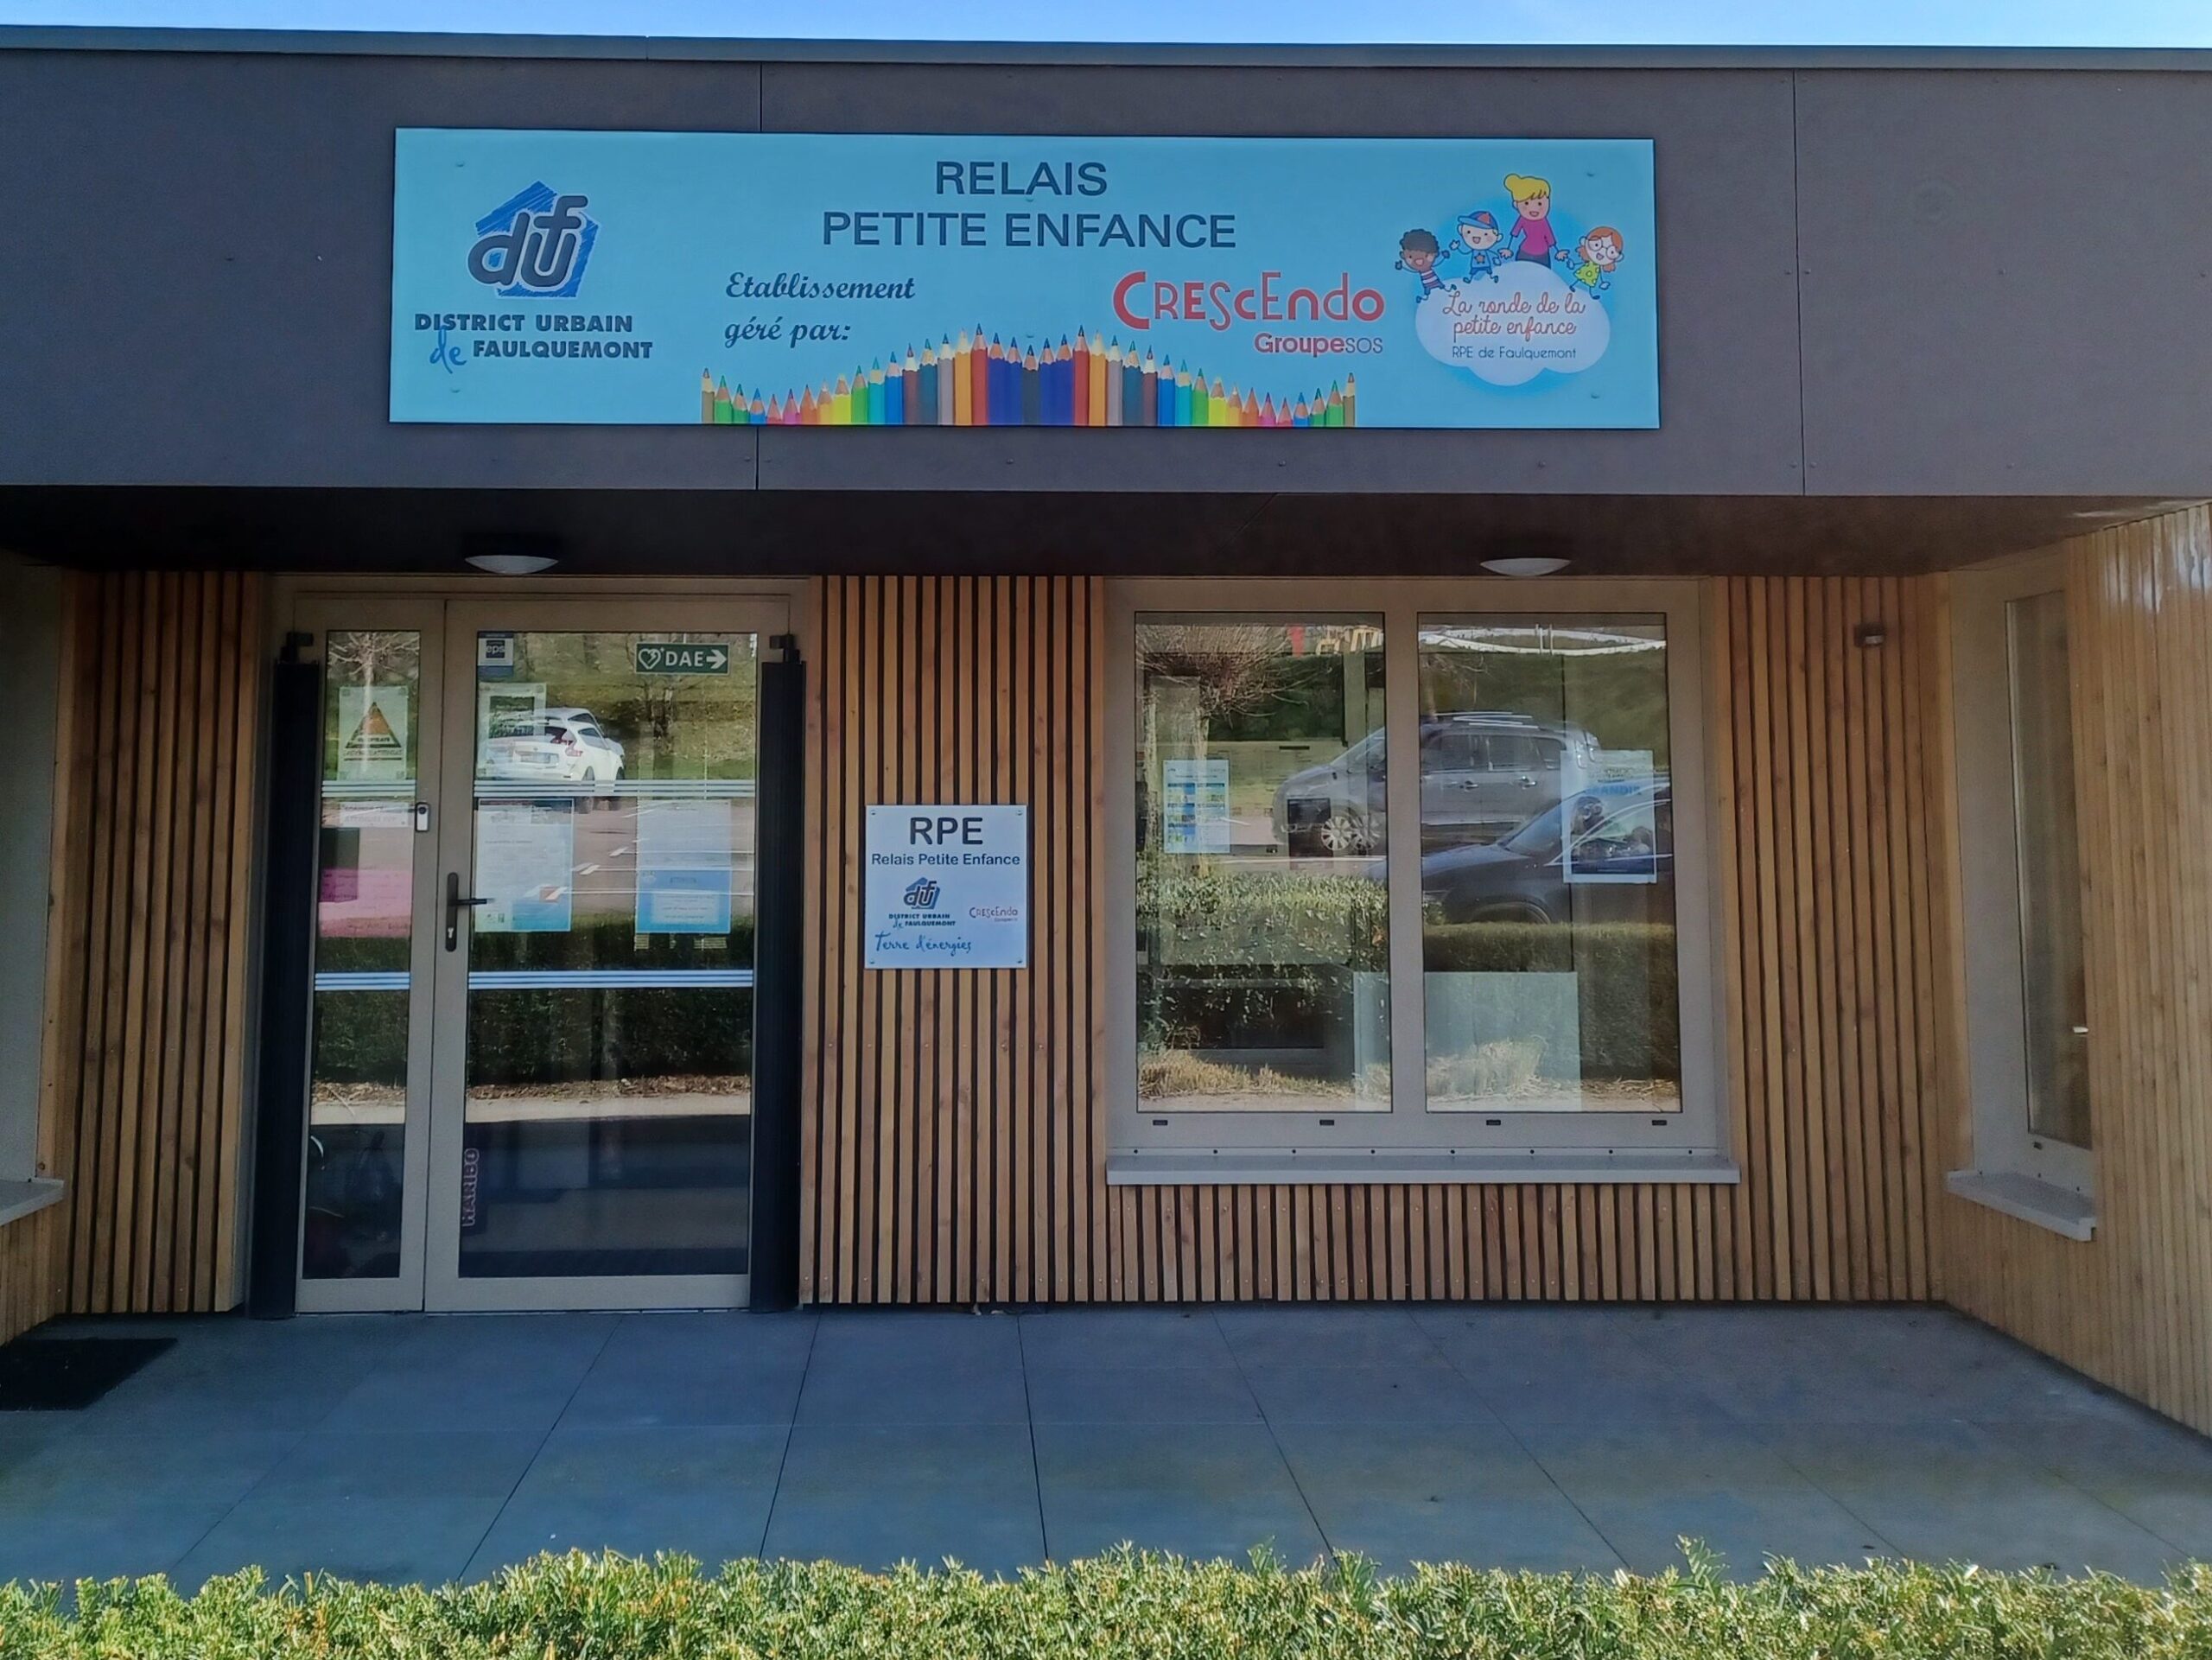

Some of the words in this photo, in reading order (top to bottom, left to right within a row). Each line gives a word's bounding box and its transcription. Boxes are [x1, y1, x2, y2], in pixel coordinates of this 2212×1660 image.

[936, 161, 1107, 196] RELAIS
[823, 212, 987, 246] PETITE
[1005, 213, 1236, 248] ENFANCE
[725, 271, 915, 299] Etablissement
[1442, 290, 1472, 316] La
[1478, 291, 1532, 315] ronde
[1536, 291, 1559, 315] de
[1564, 291, 1586, 315] la
[415, 313, 525, 332] DISTRICT
[535, 315, 632, 333] URBAIN
[724, 315, 783, 348] géré
[790, 322, 851, 348] par:
[1453, 315, 1501, 343] petite
[1506, 315, 1577, 342] enfance
[429, 325, 467, 374] de
[473, 340, 653, 359] FAULQUEMONT
[1452, 346, 1473, 359] RPE
[1478, 346, 1495, 359] de
[1499, 346, 1576, 360] Faulquemont
[665, 651, 704, 667] DAE
[910, 817, 983, 845] RPE
[872, 853, 914, 865] Relais
[918, 853, 959, 865] Petite
[963, 853, 1020, 865] Enfance
[874, 930, 910, 951] Terre
